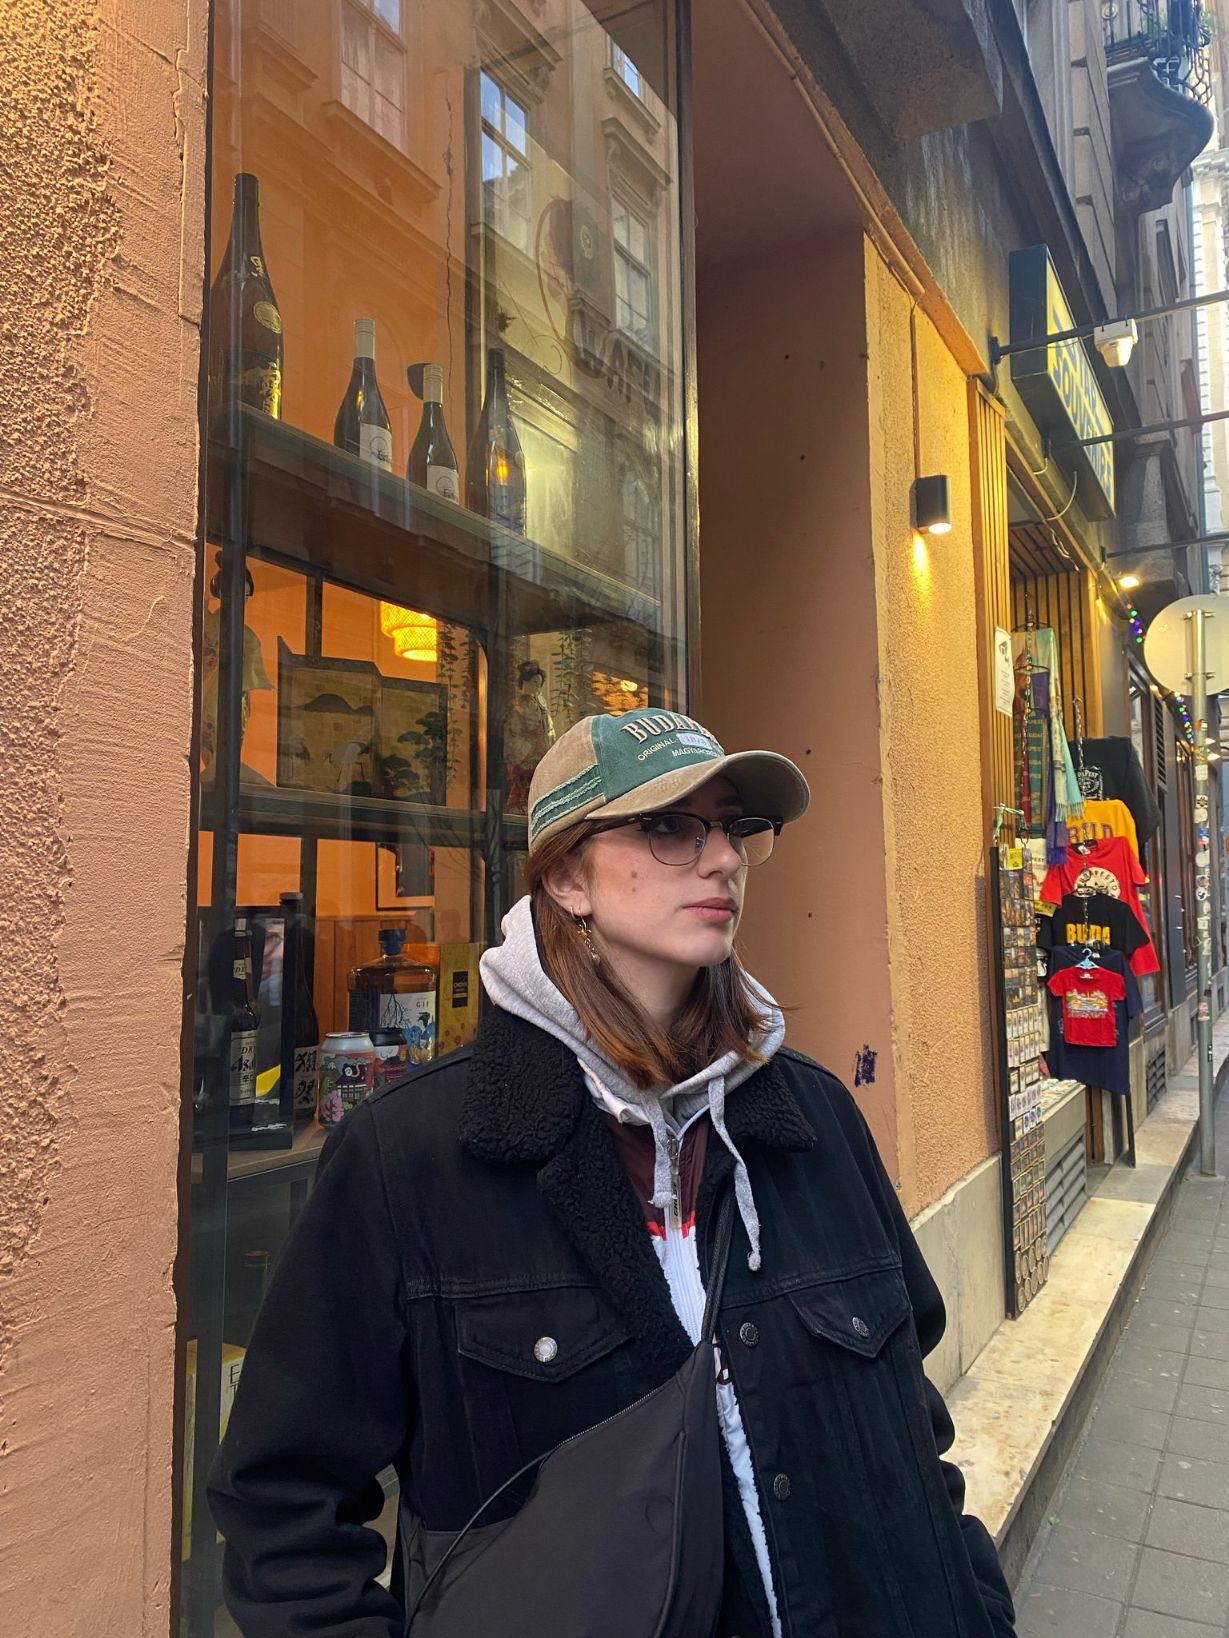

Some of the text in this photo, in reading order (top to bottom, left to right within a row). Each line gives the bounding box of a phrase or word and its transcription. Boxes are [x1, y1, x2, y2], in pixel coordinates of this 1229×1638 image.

[637, 738, 676, 761] ORIGINAL
[1065, 923, 1111, 945] BUDA
[241, 1046, 255, 1054] DR
